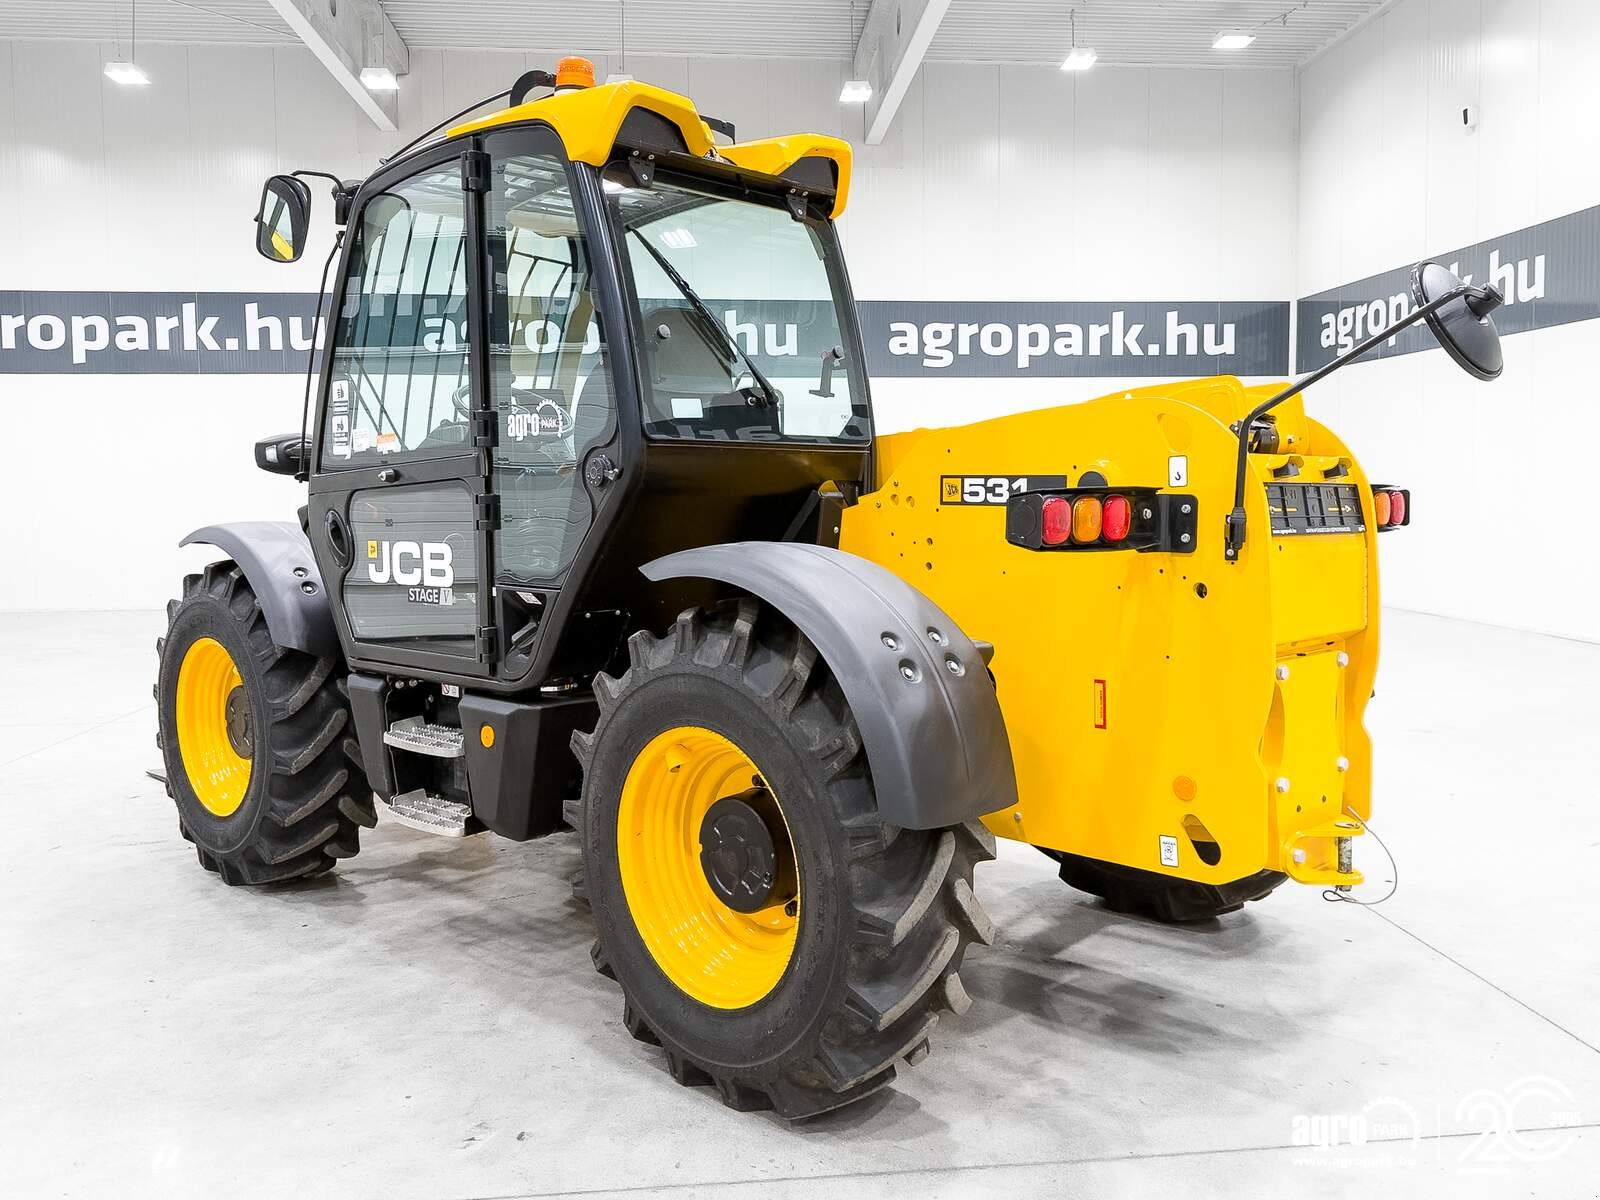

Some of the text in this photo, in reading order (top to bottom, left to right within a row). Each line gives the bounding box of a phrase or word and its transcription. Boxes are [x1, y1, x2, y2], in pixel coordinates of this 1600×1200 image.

[888, 310, 1236, 369] agropark.hu
[507, 413, 560, 441] agro PARK
[368, 540, 454, 588] JCB
[408, 587, 439, 604] STAGE
